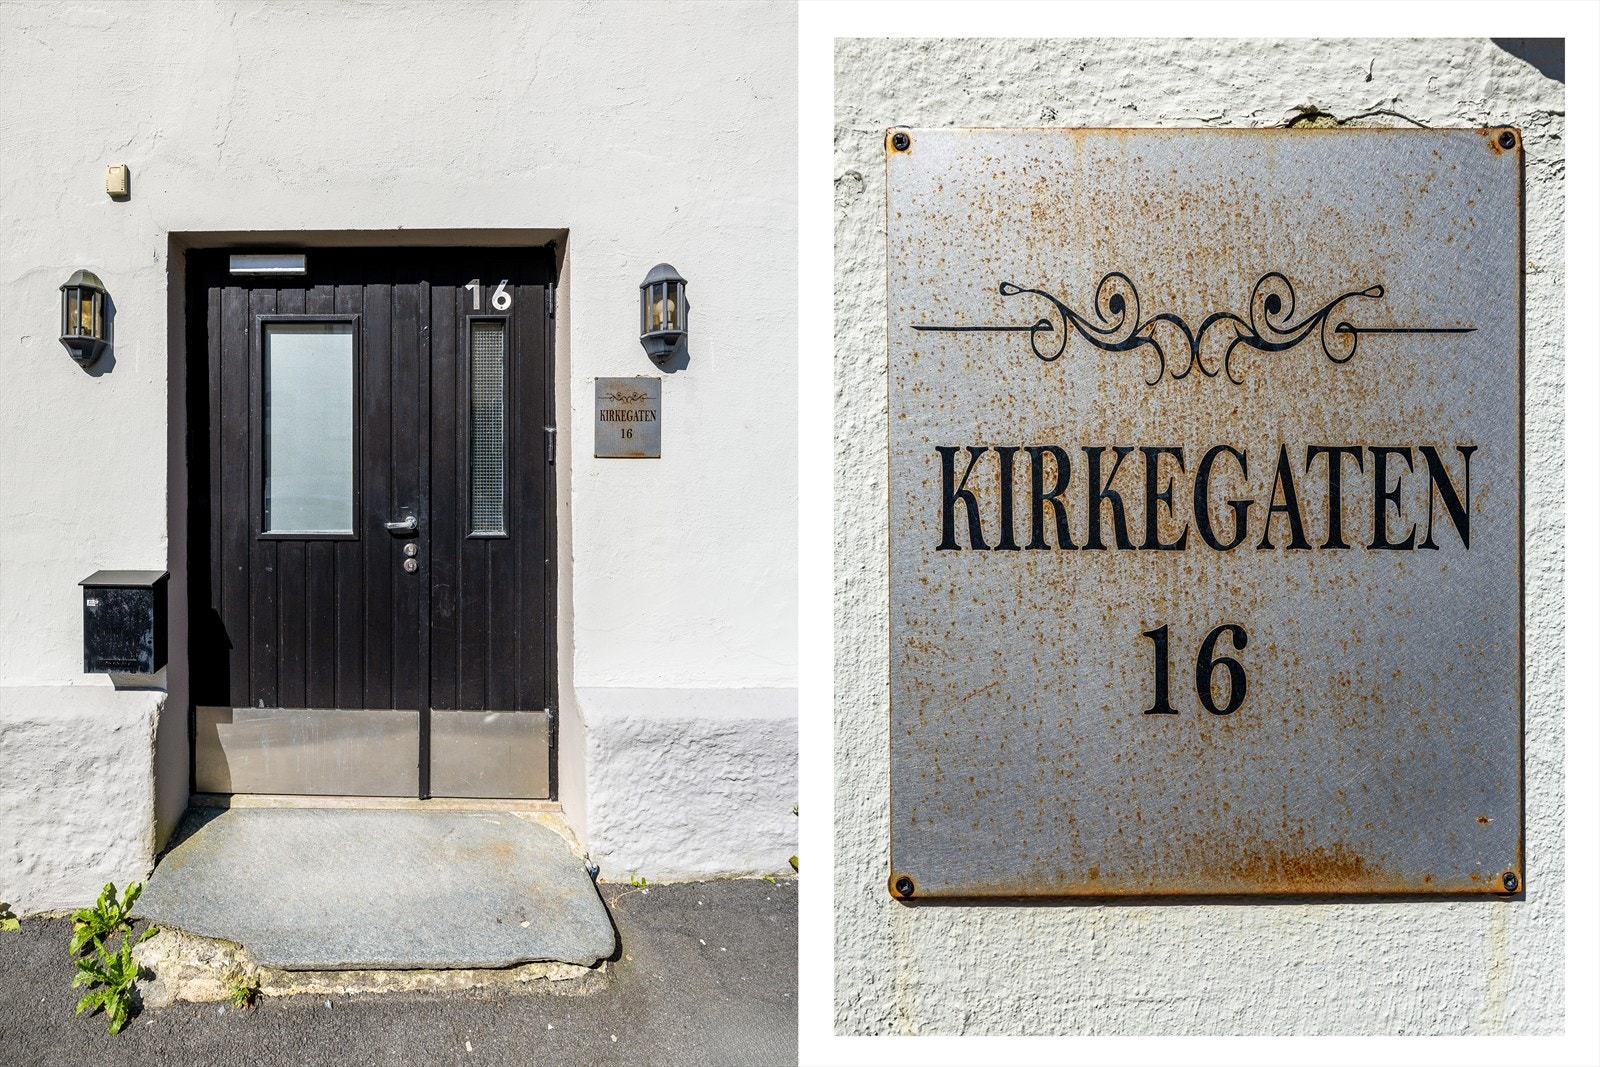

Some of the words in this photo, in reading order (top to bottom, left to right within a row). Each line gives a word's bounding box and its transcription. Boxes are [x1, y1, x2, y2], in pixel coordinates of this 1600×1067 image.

[464, 278, 512, 311] 16
[600, 409, 656, 422] KIRKEGATEN
[621, 428, 633, 439] 16
[935, 443, 1478, 552] KIRKEGATEN
[1143, 623, 1248, 716] 16
